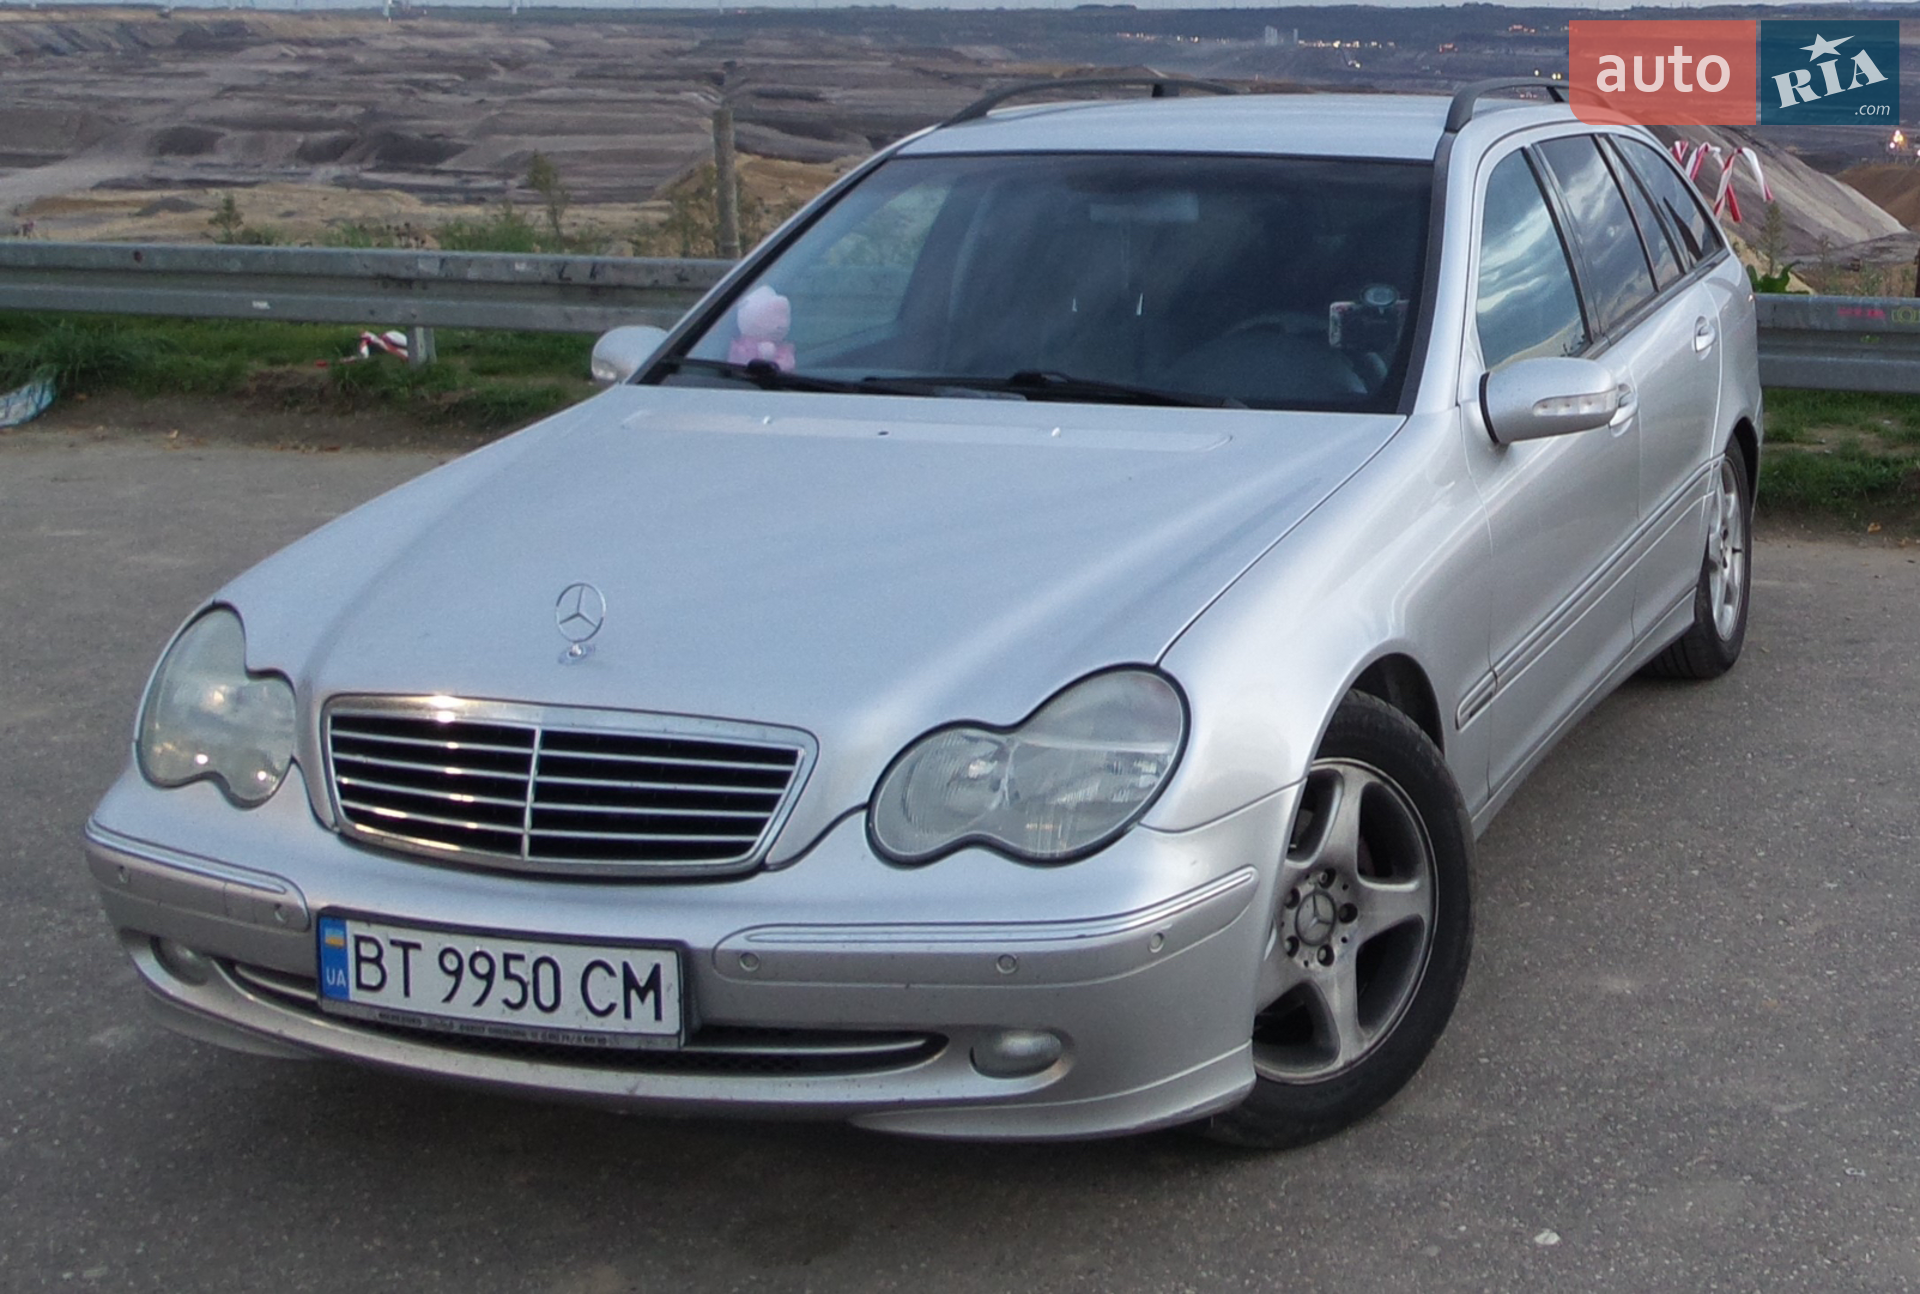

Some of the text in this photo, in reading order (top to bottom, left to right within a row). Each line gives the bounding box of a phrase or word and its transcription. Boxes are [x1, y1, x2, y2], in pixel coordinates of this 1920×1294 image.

[326, 967, 347, 988] UA
[353, 934, 663, 1022] BT 9950 CM
